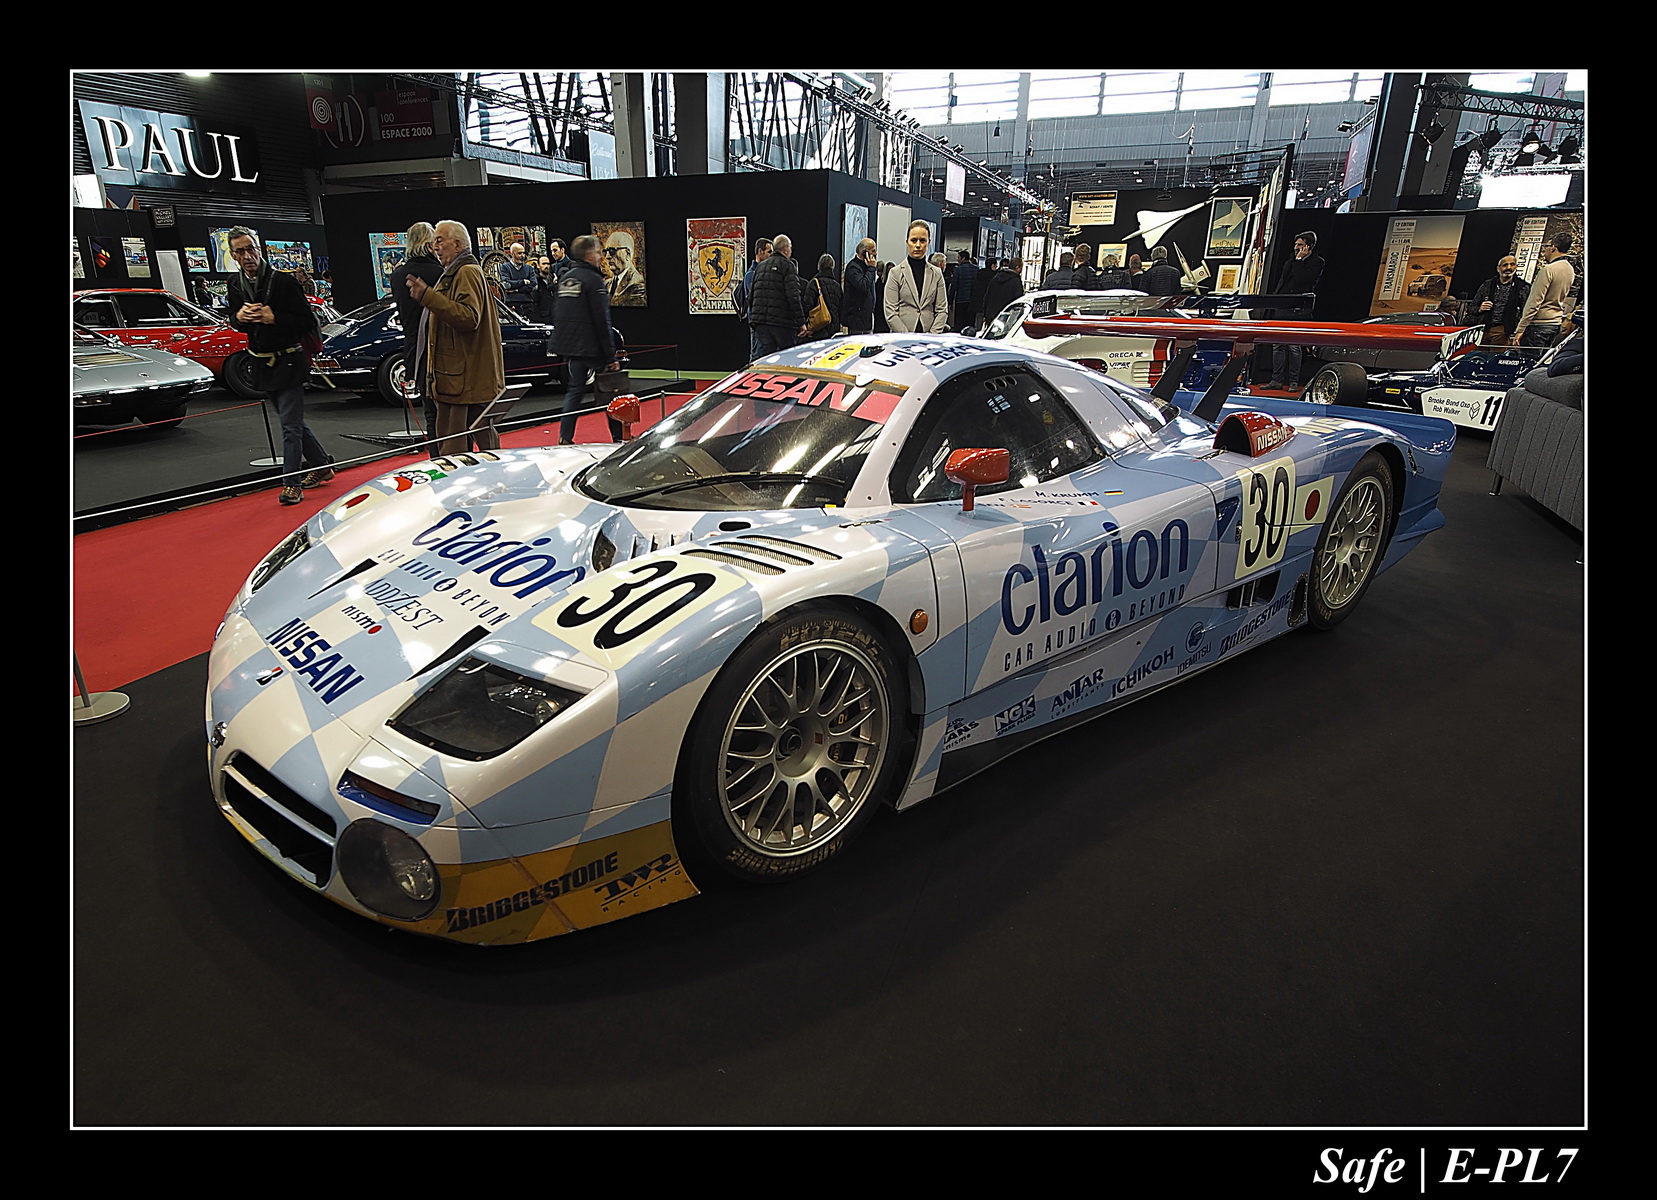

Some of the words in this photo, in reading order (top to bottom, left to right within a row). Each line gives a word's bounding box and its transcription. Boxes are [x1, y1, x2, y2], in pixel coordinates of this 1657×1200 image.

[380, 112, 395, 123] 100
[399, 90, 416, 99] espace
[91, 115, 259, 184] PAUL
[381, 128, 410, 139] ESPACE
[412, 126, 433, 137] 2000
[1427, 396, 1446, 405] Brooke
[1445, 399, 1460, 407] Bond
[1460, 401, 1471, 409] Oxo
[1480, 396, 1504, 426] 11
[1432, 405, 1443, 413] Rob
[1443, 406, 1461, 416] Walker
[1256, 427, 1289, 451] NISSAN
[1244, 466, 1290, 568] 30
[1001, 518, 1190, 636] clarion
[557, 560, 717, 650] 30
[1004, 643, 1034, 673] CAR
[1045, 617, 1097, 654] AUDIO
[1105, 609, 1122, 631] &
[1129, 583, 1186, 621] BEYOND
[1217, 588, 1292, 659] BRIDGESTONE
[264, 617, 365, 705] NISSAN
[1111, 645, 1175, 698] ICHIKOH
[1176, 642, 1213, 676] IDEMITSU
[995, 696, 1036, 730] NGK
[1051, 668, 1105, 712] ANTAR
[447, 851, 619, 934] BRIDGESTONE
[594, 853, 672, 901] TWR
[602, 869, 682, 914] RACING
